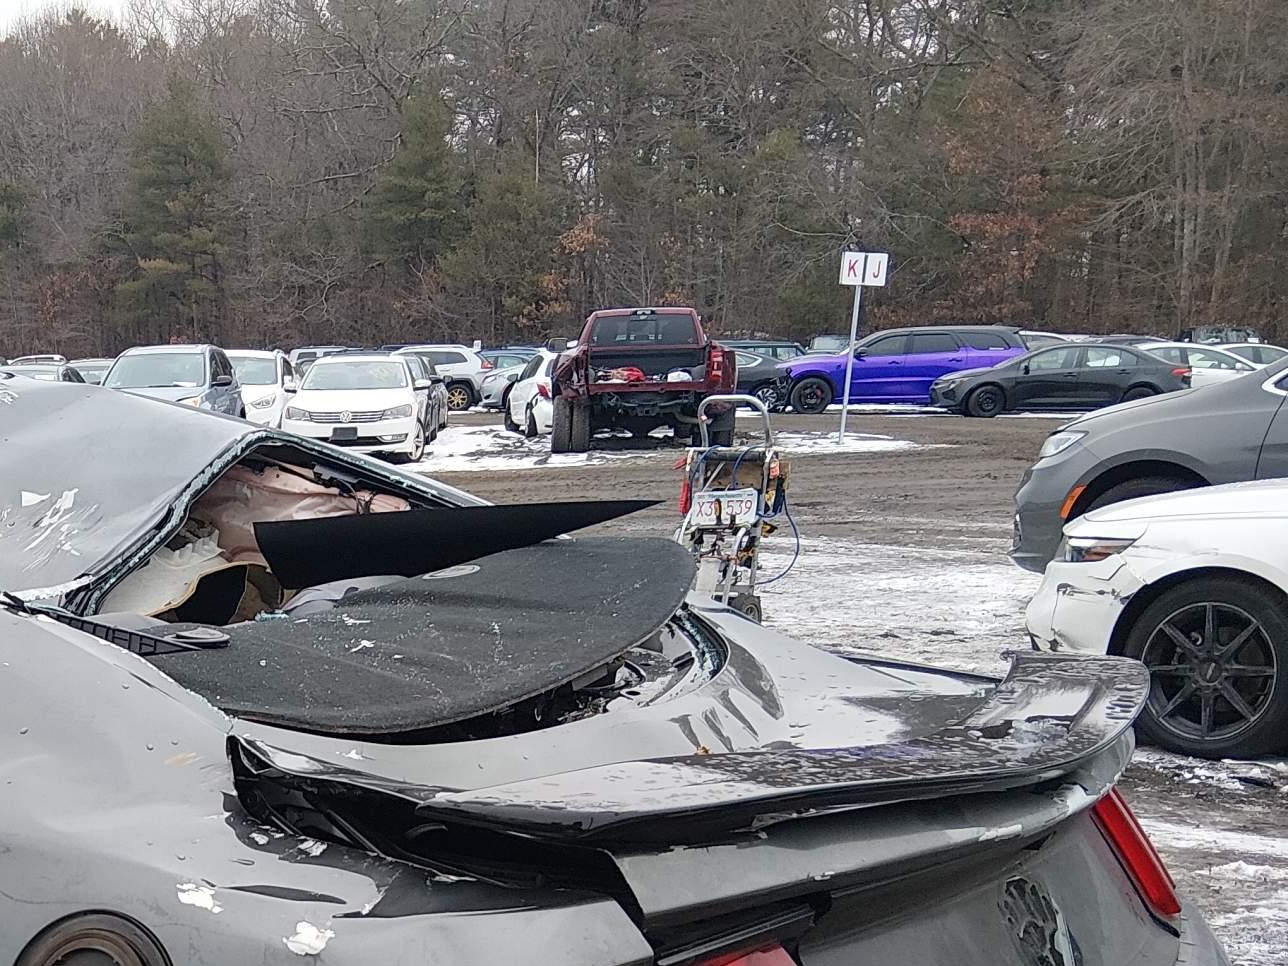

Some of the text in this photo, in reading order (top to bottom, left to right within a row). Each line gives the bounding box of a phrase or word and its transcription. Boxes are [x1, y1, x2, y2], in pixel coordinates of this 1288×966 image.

[847, 259, 882, 279] K J
[726, 499, 753, 516] 539
